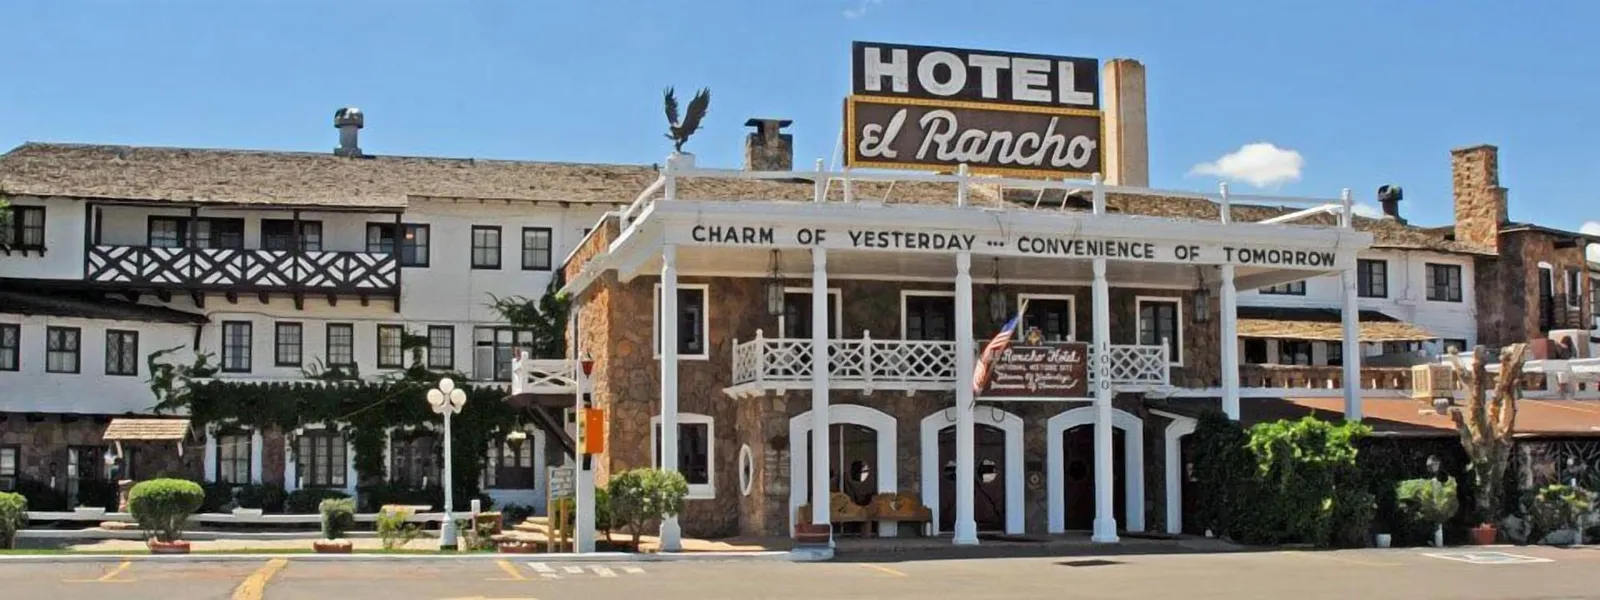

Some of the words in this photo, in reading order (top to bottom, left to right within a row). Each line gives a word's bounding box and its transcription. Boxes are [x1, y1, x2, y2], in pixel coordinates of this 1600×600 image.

[864, 47, 1094, 105] HOTEL
[859, 108, 908, 159] El
[915, 109, 1097, 168] Rancho
[692, 225, 774, 244] CHARM
[797, 228, 827, 245] OF
[849, 230, 976, 250] YESTERDAY
[1017, 235, 1155, 259] CONVENIENCE
[1174, 244, 1200, 261] OF
[1223, 246, 1336, 267] TOMORROW
[1002, 349, 1046, 363] Rancho
[1047, 348, 1081, 362] Hotel
[1101, 341, 1110, 390] 1000
